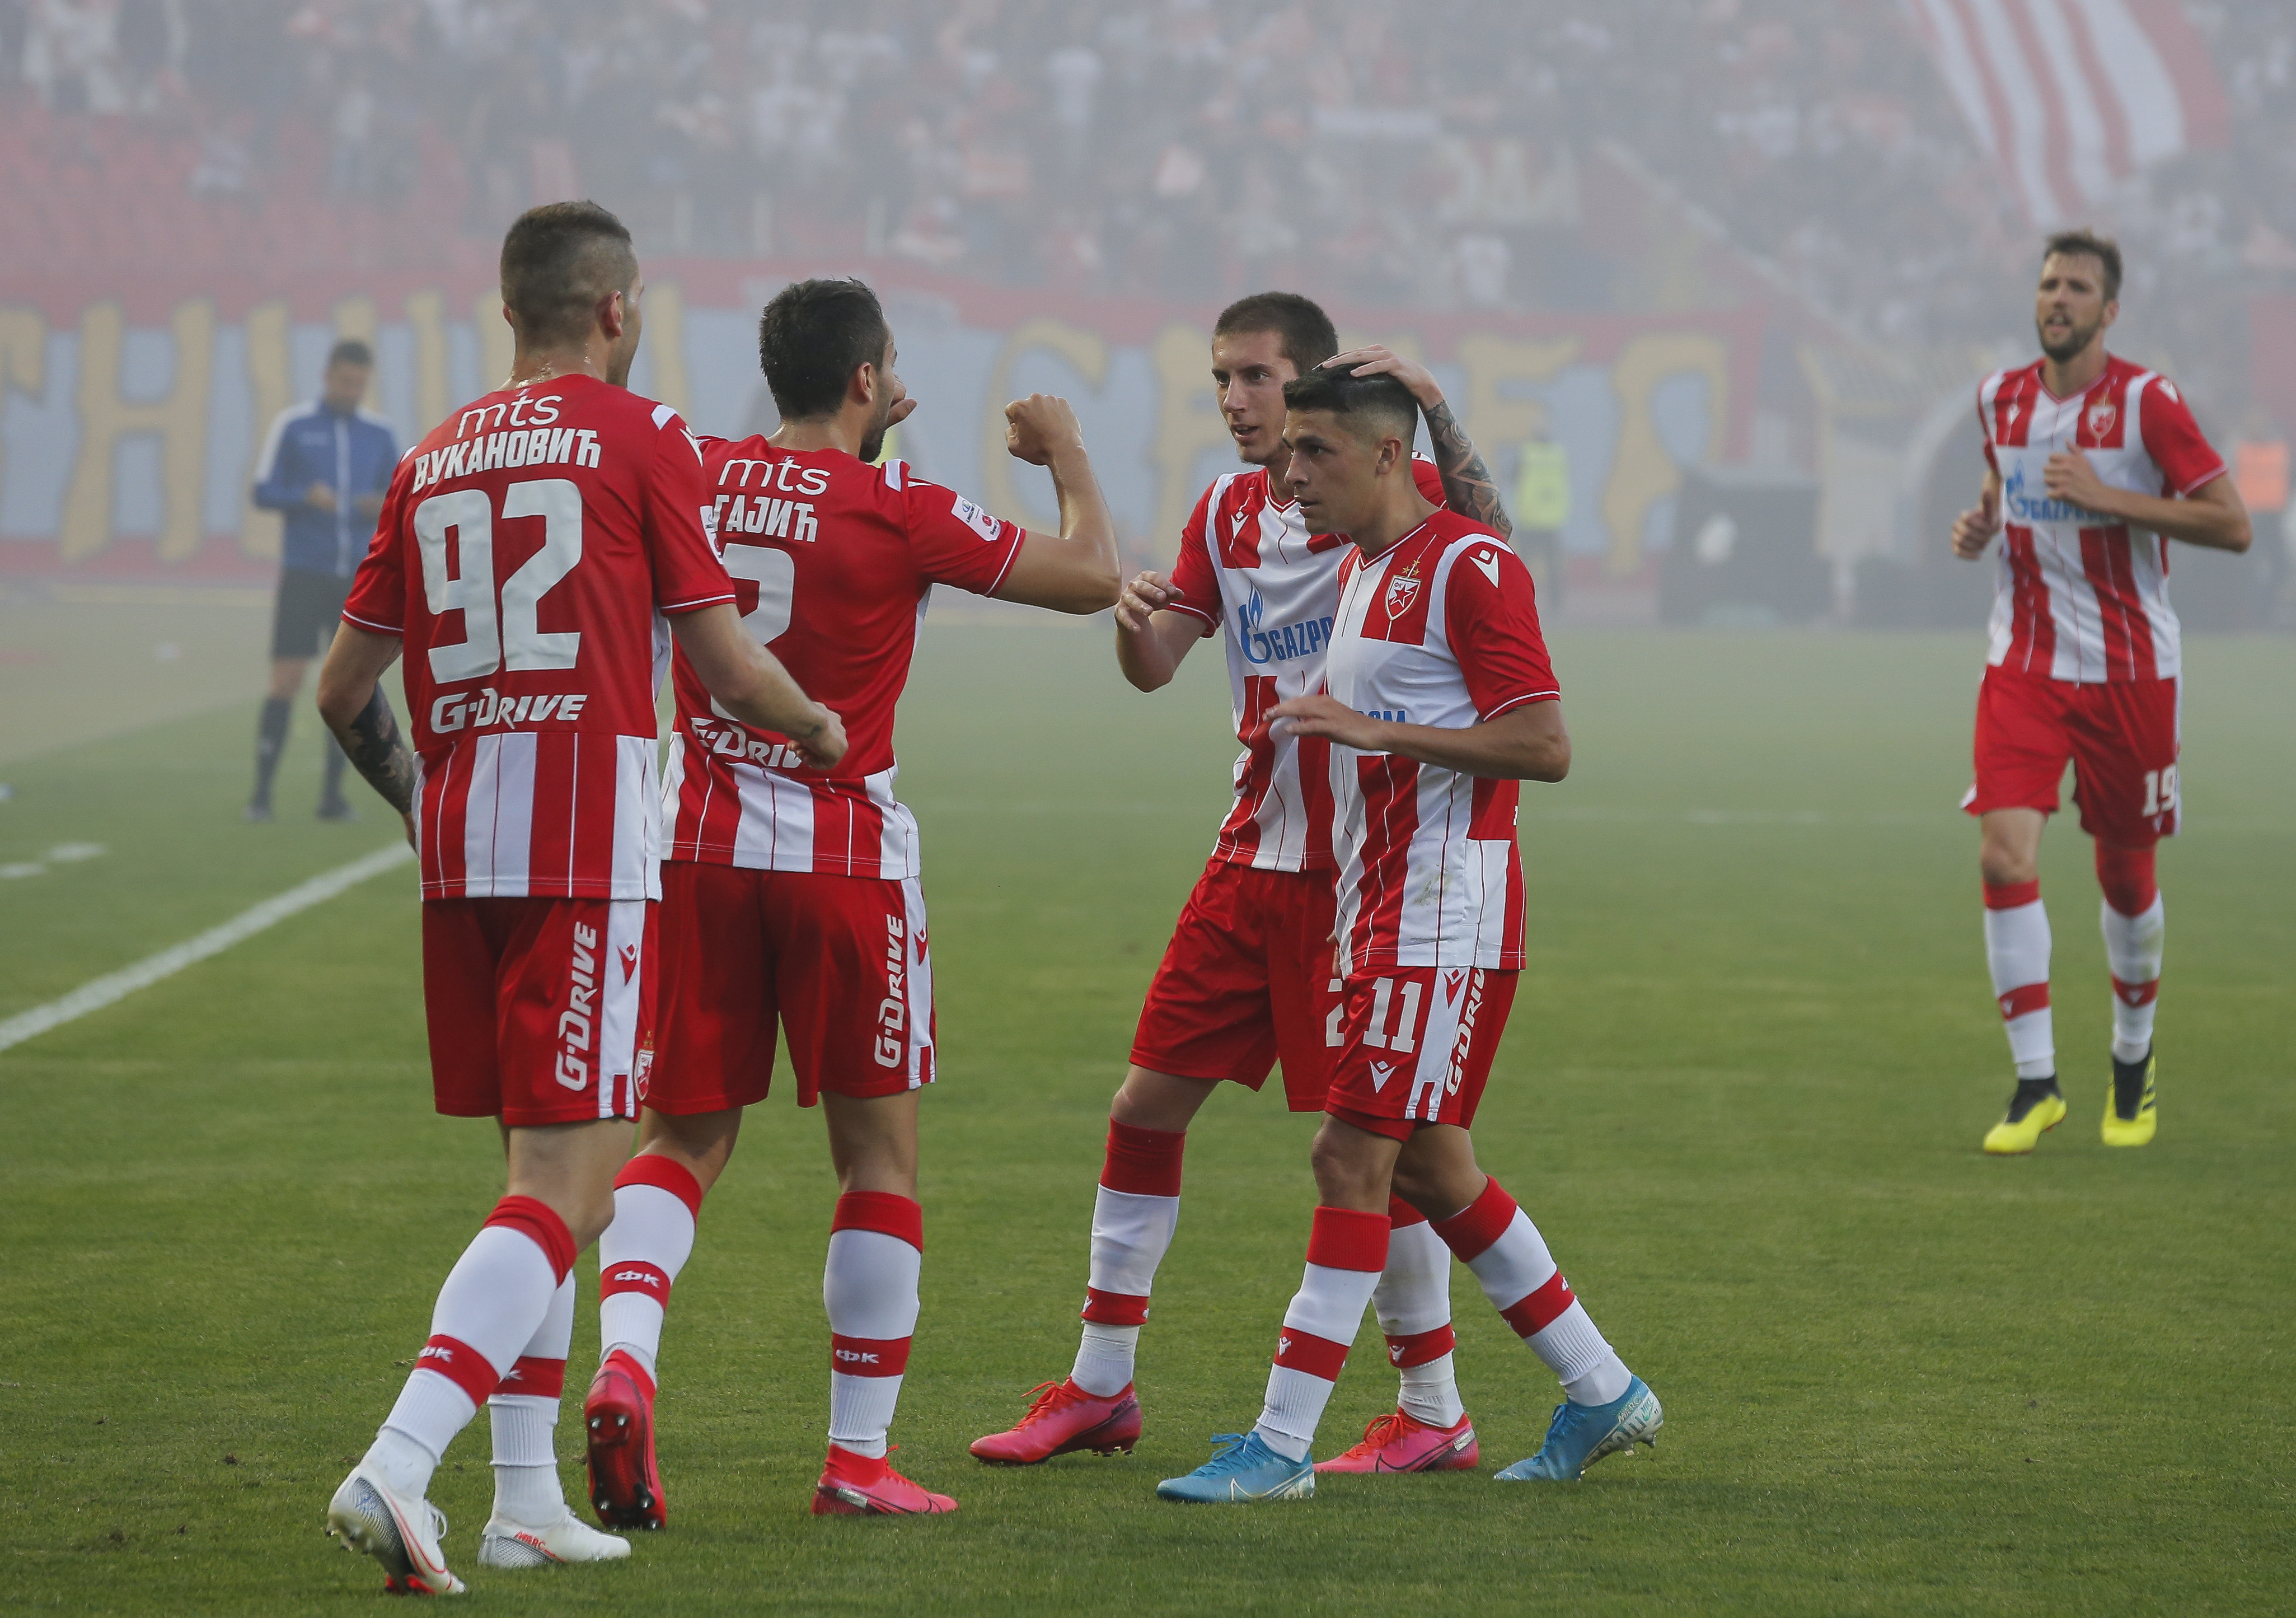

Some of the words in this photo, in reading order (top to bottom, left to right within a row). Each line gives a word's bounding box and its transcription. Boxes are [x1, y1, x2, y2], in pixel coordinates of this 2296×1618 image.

[456, 391, 563, 439] mts
[413, 428, 601, 494] ВУКАНОВИЋ
[719, 457, 831, 495] mts
[713, 494, 818, 543] ГАЈИЋ
[414, 479, 582, 684] 92
[1268, 616, 1334, 661] GAZPR
[691, 717, 802, 768] G-DRIV
[2143, 764, 2177, 817] 19
[1362, 977, 1422, 1053] 11
[1446, 969, 1484, 1096] G-DRIV
